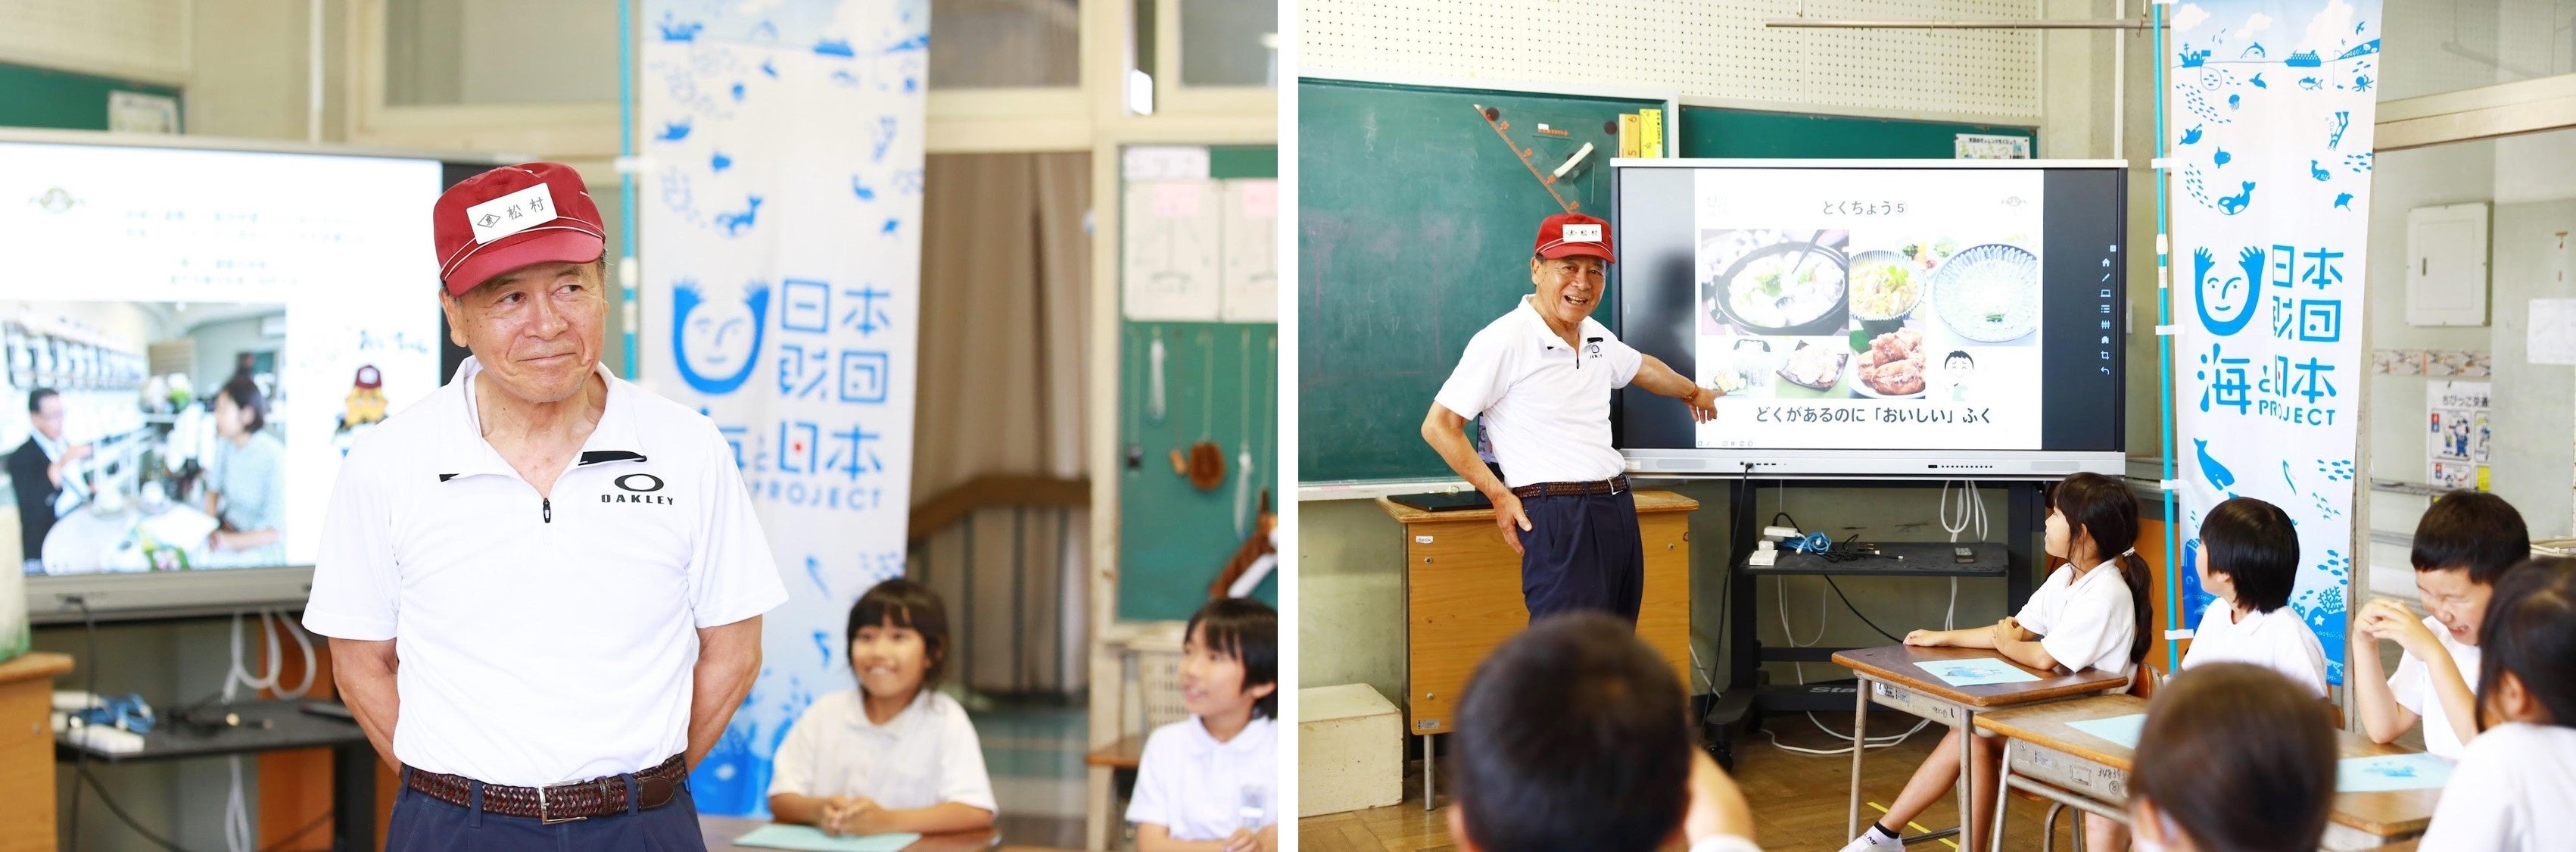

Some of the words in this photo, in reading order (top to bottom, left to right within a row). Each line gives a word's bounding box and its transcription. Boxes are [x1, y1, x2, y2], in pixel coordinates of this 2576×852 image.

[507, 196, 544, 220] 松村
[2272, 245, 2344, 290] 日本
[780, 278, 890, 338] 日本
[777, 343, 889, 404] 財団
[2197, 342, 2337, 415] 海と日本
[1756, 406, 1992, 424] どくがあるのに「おいしい」ふく
[2259, 399, 2335, 426] PROJECT
[601, 494, 674, 506] OAKLEY
